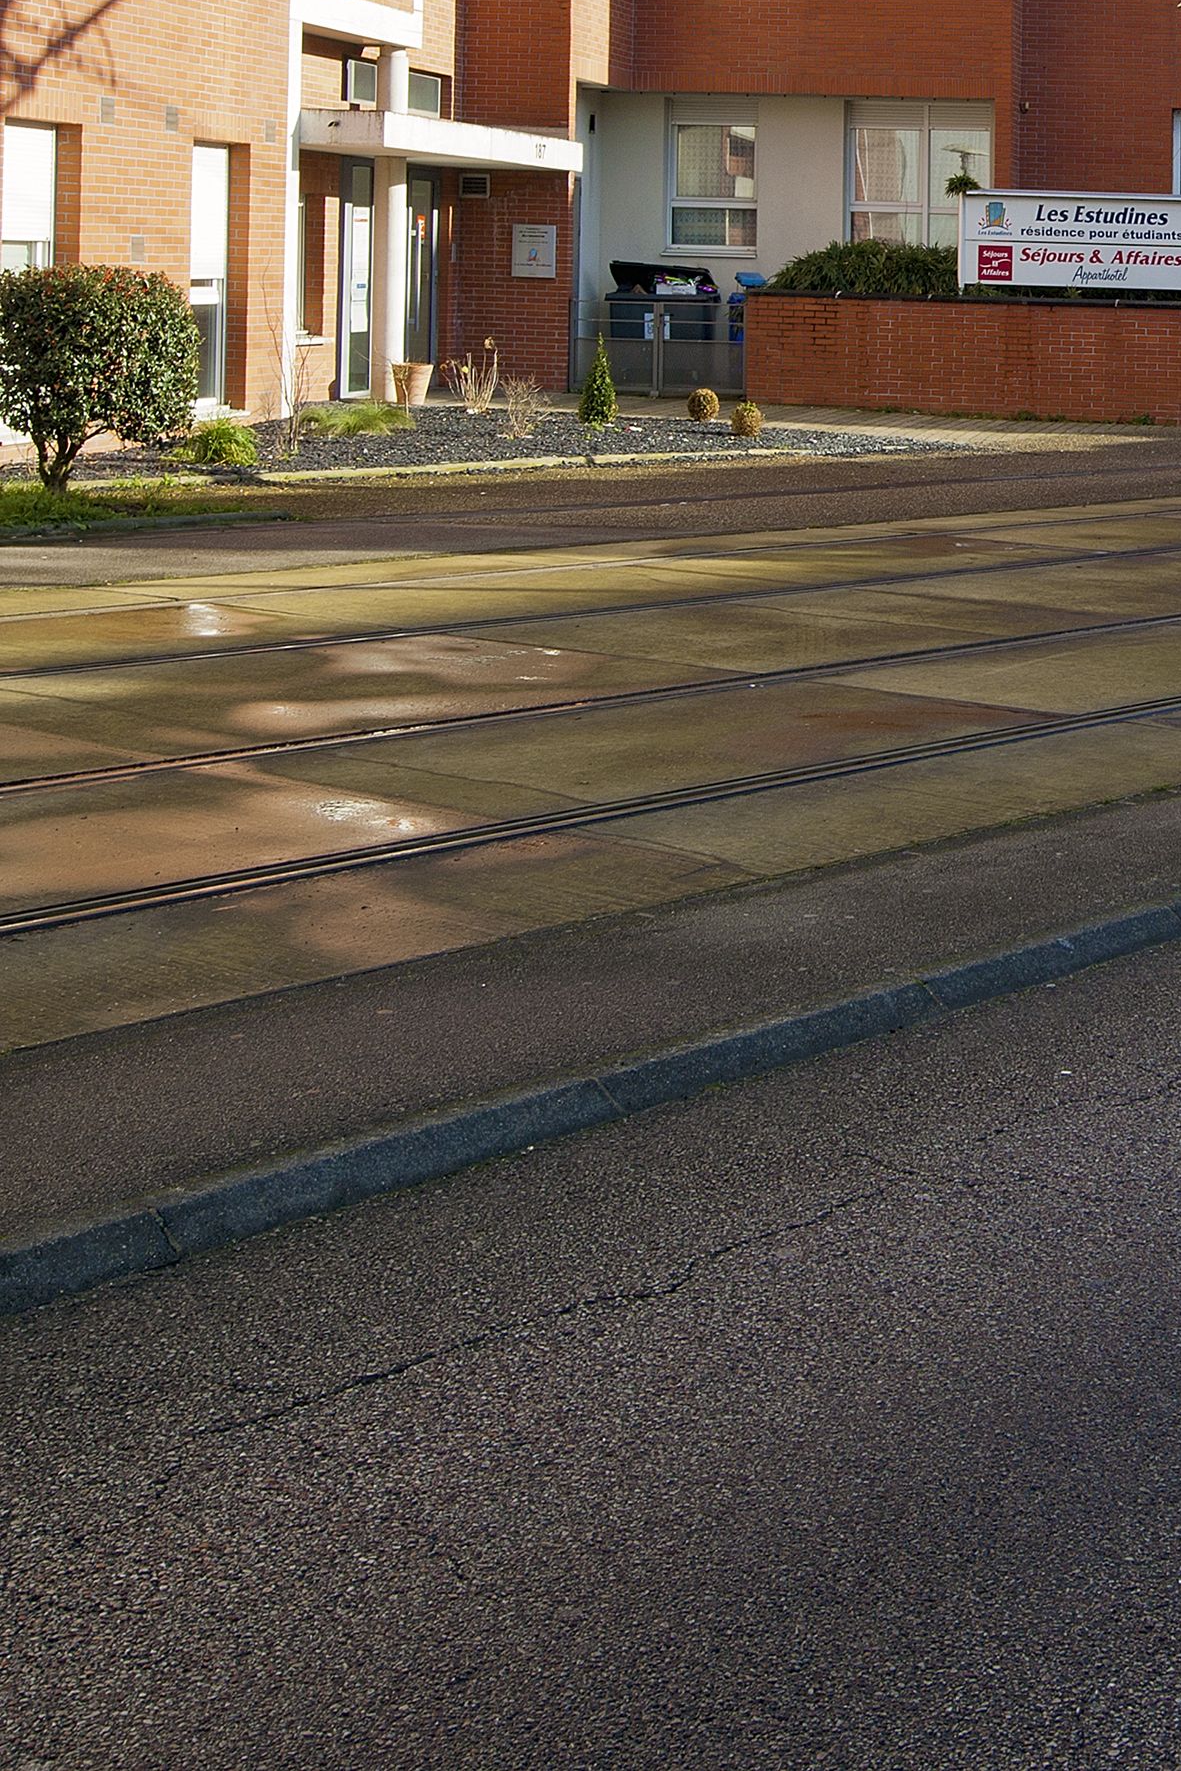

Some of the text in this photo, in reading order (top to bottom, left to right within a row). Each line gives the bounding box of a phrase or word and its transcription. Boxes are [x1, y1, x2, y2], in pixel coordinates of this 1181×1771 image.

[535, 143, 546, 160] 187
[1035, 204, 1169, 225] Les Estudines
[1020, 226, 1085, 238] résidence
[1089, 229, 1119, 240] pour
[982, 250, 1008, 259] Séjours
[1019, 247, 1085, 266] Séjours
[1089, 249, 1105, 264] &
[1072, 265, 1129, 284] Apparthotel
